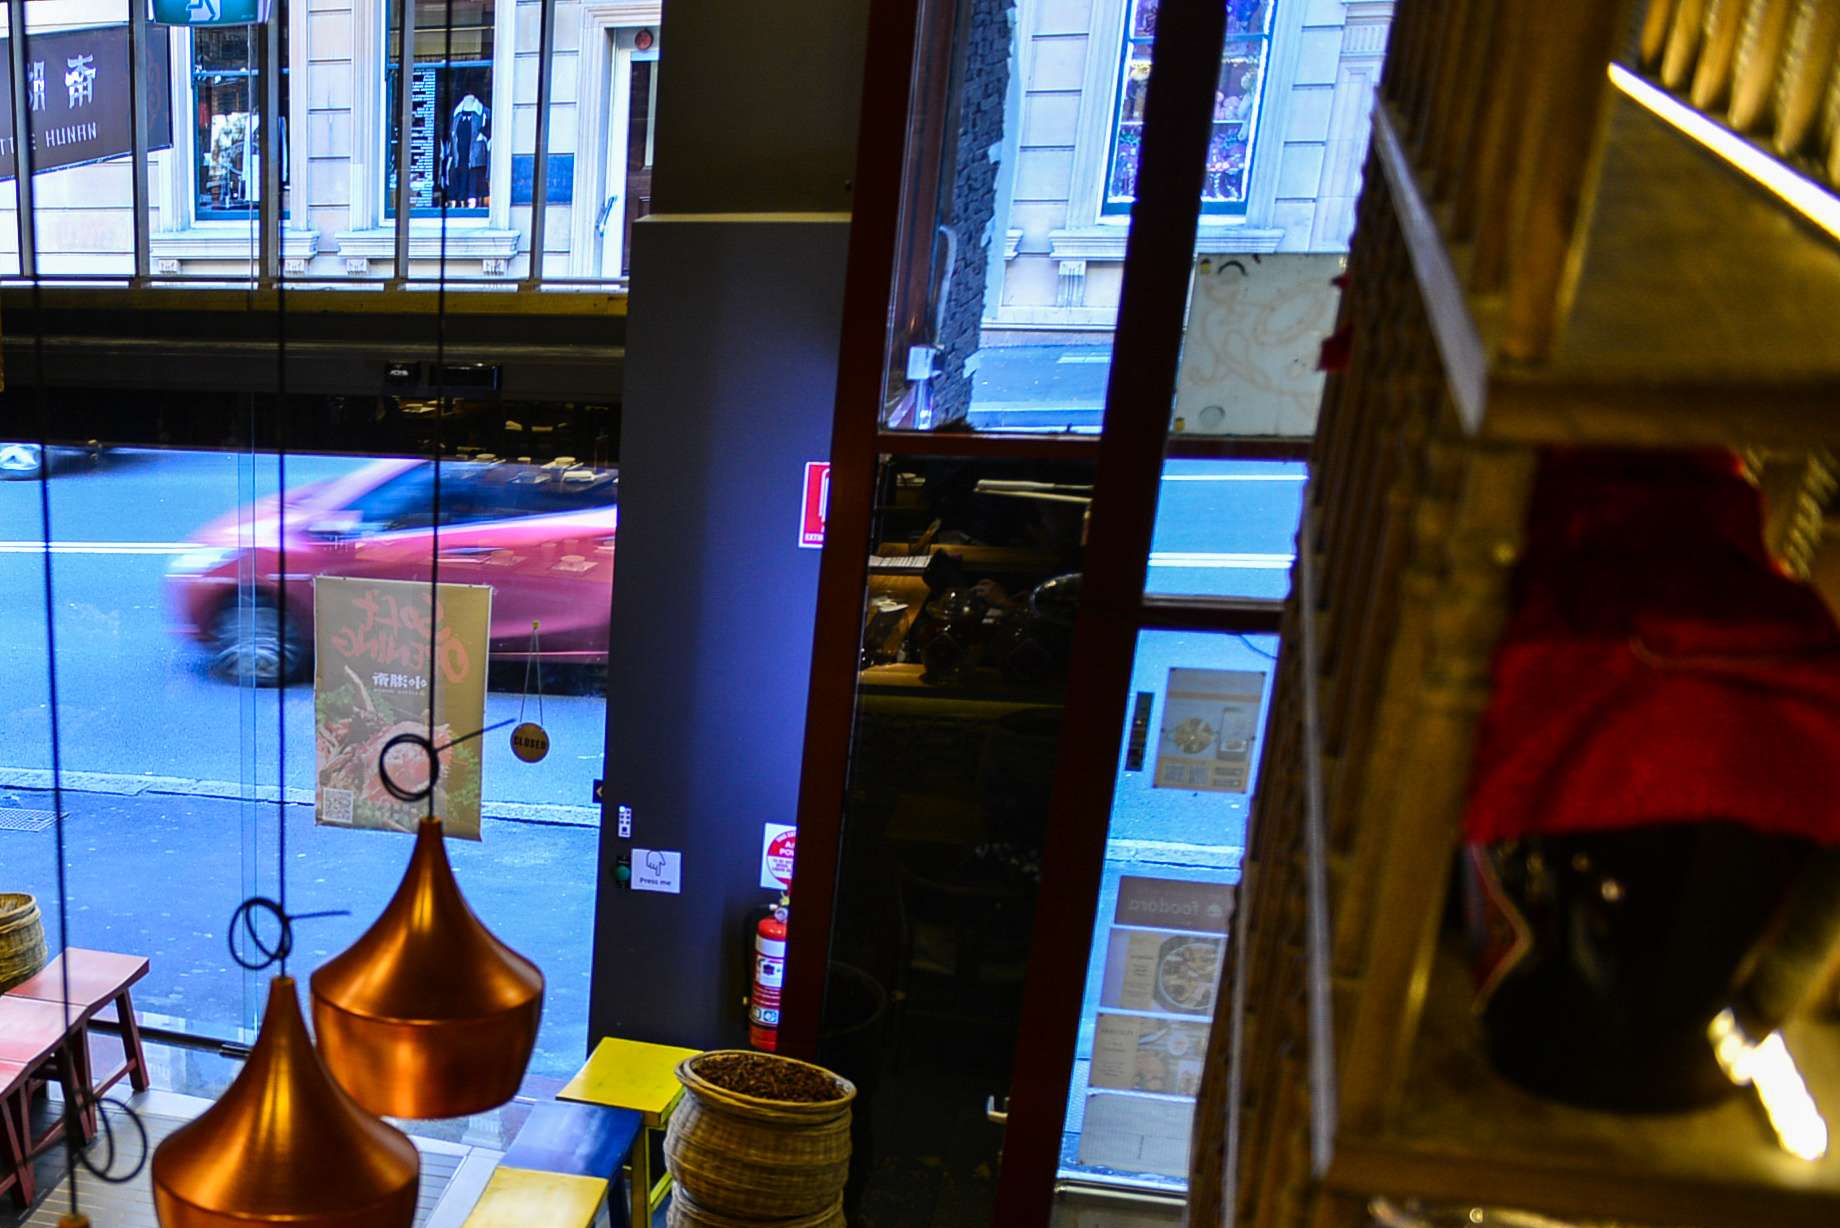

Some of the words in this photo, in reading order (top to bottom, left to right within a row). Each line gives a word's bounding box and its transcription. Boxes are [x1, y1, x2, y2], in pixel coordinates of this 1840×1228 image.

[45, 122, 97, 148] HUNAN
[513, 734, 546, 750] CLOSED
[639, 876, 658, 885] Press
